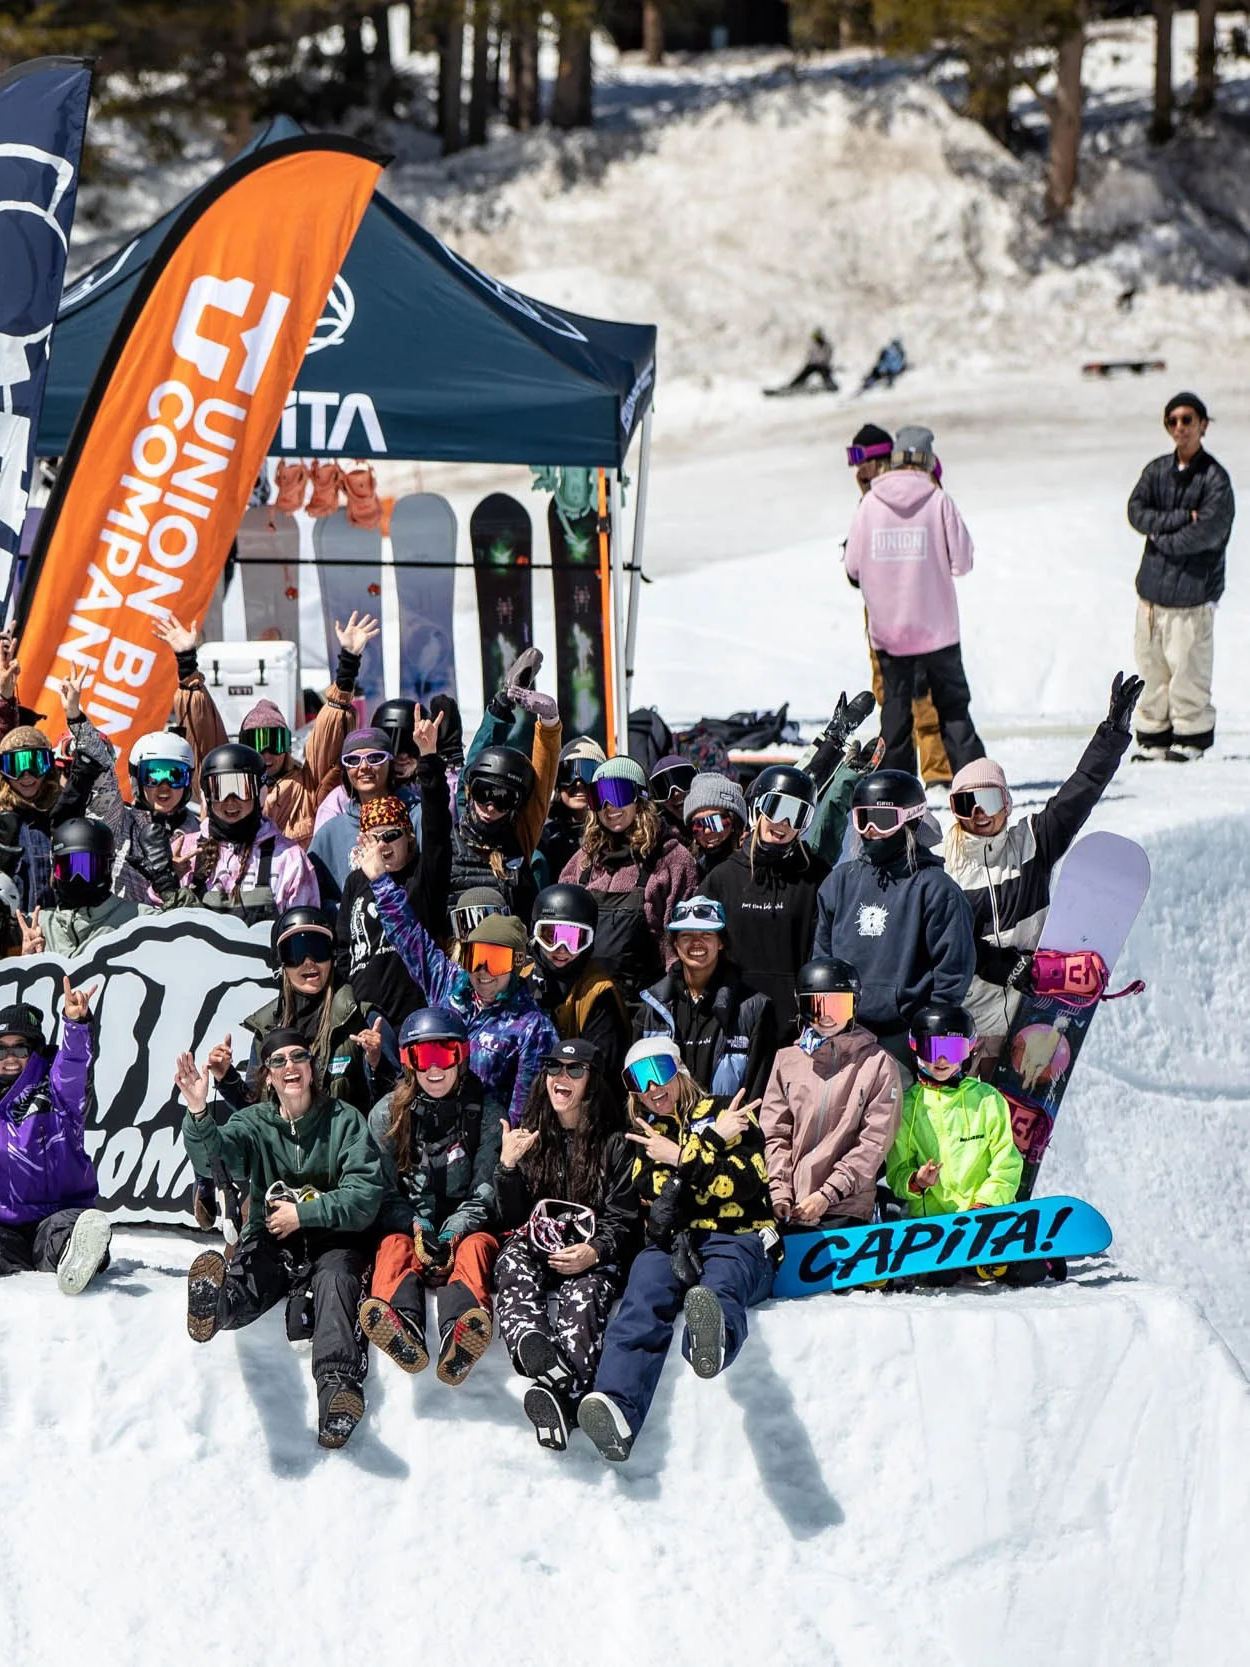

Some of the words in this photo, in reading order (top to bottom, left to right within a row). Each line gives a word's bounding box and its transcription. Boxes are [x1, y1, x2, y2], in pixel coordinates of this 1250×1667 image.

[125, 398, 246, 620] UNION
[877, 533, 923, 551] UNION
[230, 687, 251, 695] YETI
